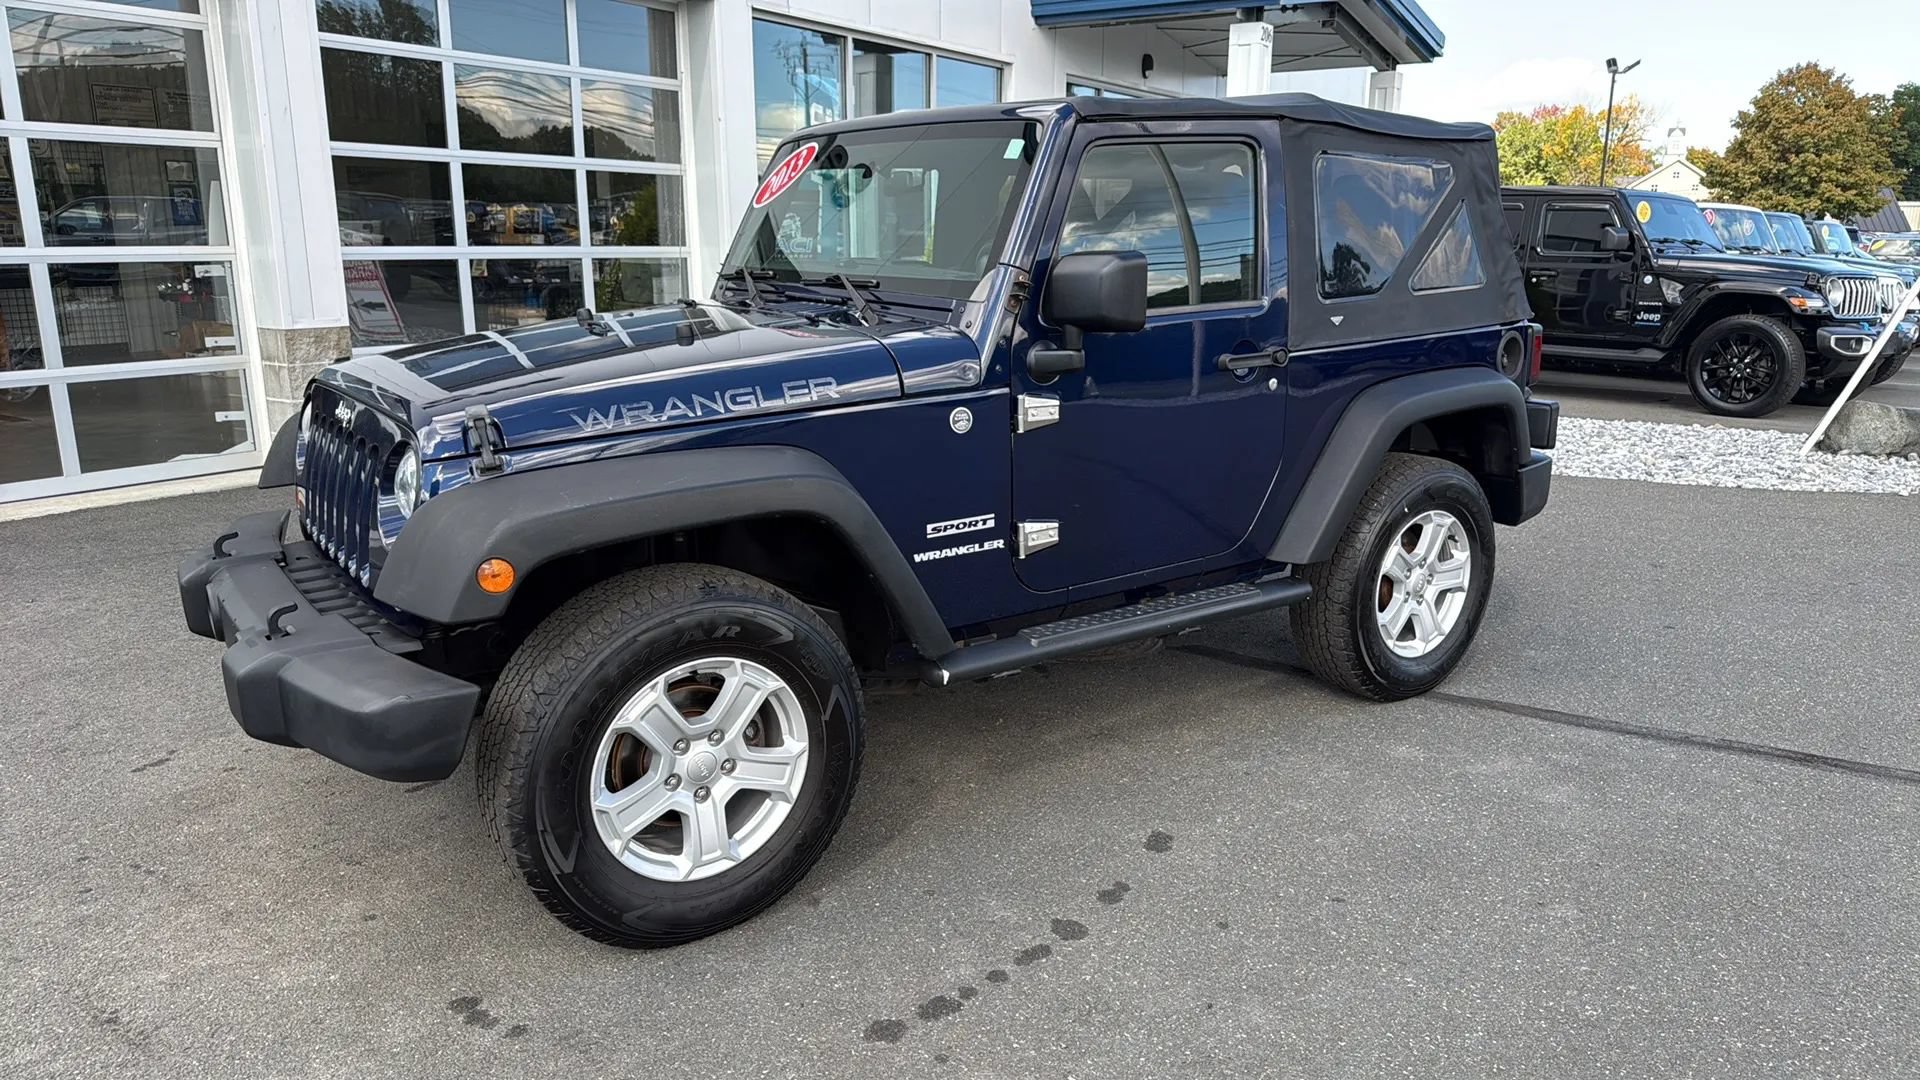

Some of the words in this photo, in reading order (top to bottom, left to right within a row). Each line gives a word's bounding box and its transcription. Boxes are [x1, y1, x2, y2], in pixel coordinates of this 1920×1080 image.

[1261, 26, 1273, 43] 206
[761, 148, 809, 203] 2013
[1636, 311, 1661, 322] Jeep
[569, 376, 841, 432] WRANGLER
[928, 518, 991, 536] SPORT
[913, 538, 1005, 563] WRANGLER
